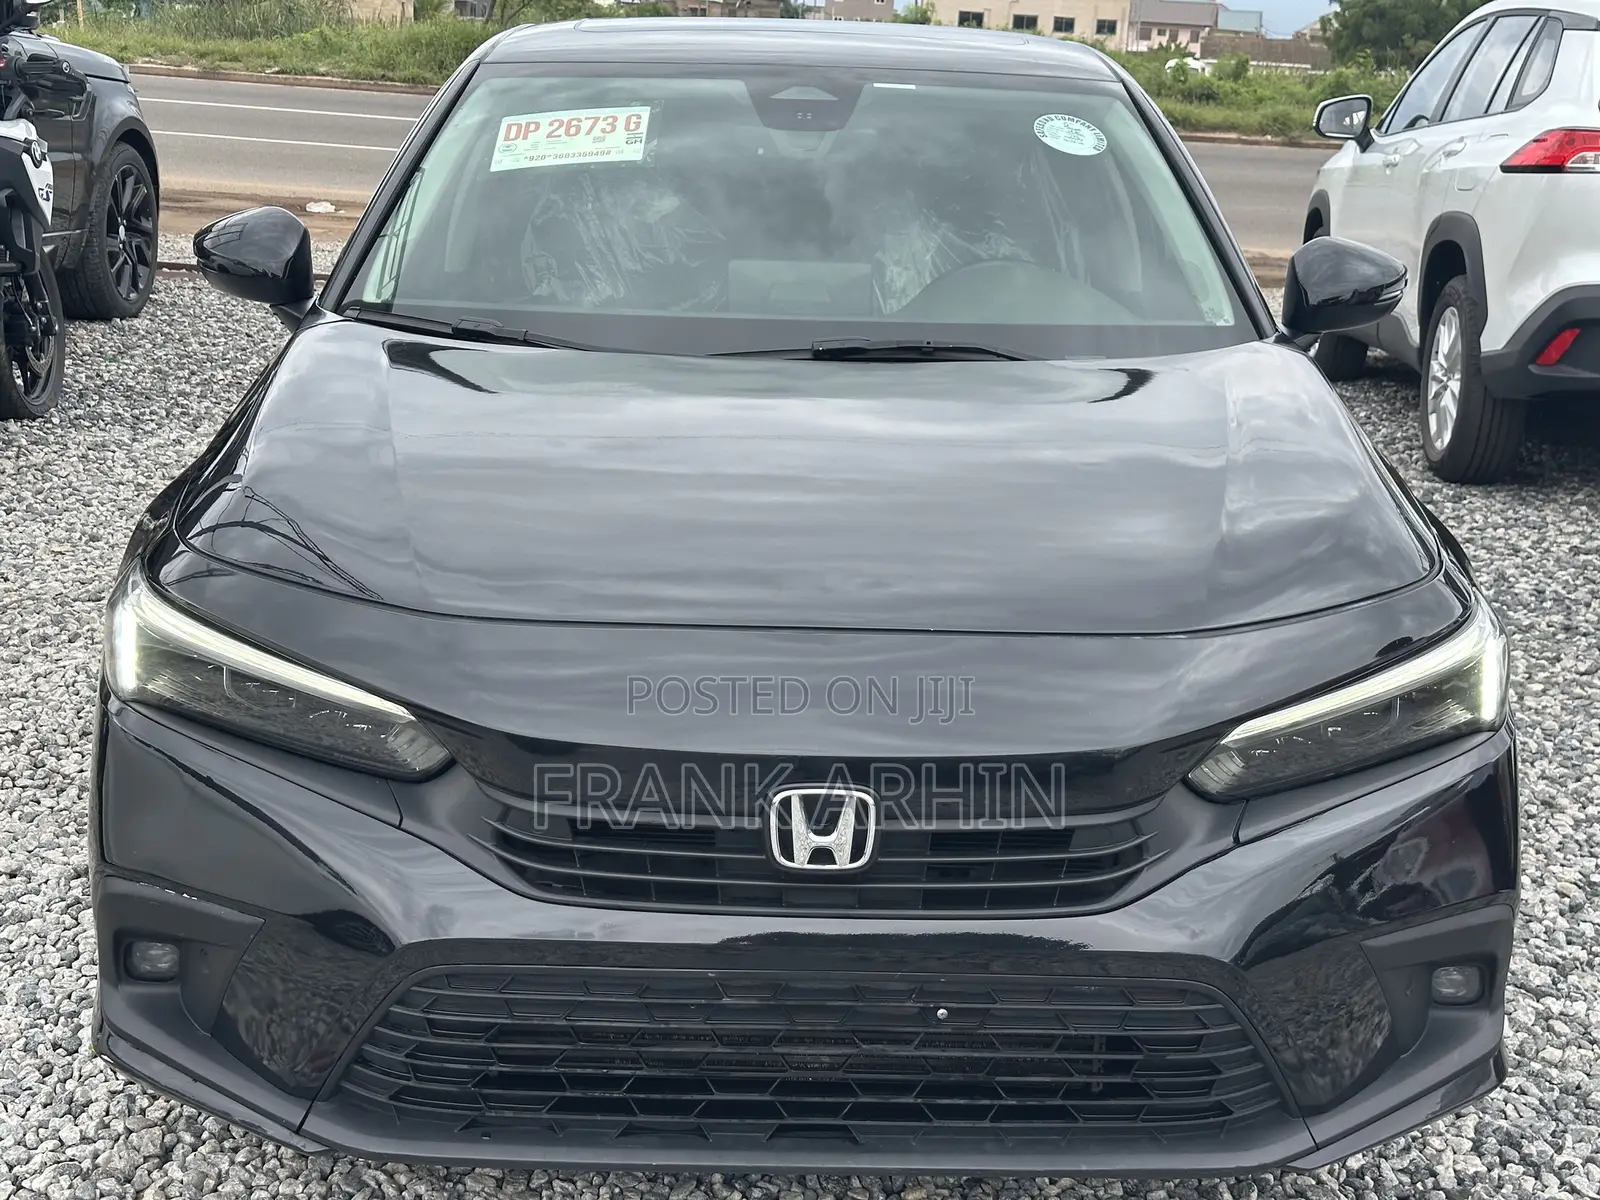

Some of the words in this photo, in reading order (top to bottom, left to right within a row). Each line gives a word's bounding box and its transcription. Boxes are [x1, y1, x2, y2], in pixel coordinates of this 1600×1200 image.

[503, 121, 541, 142] DP
[546, 115, 618, 139] 2673
[624, 113, 643, 133] G
[1054, 115, 1097, 131] COMPANY
